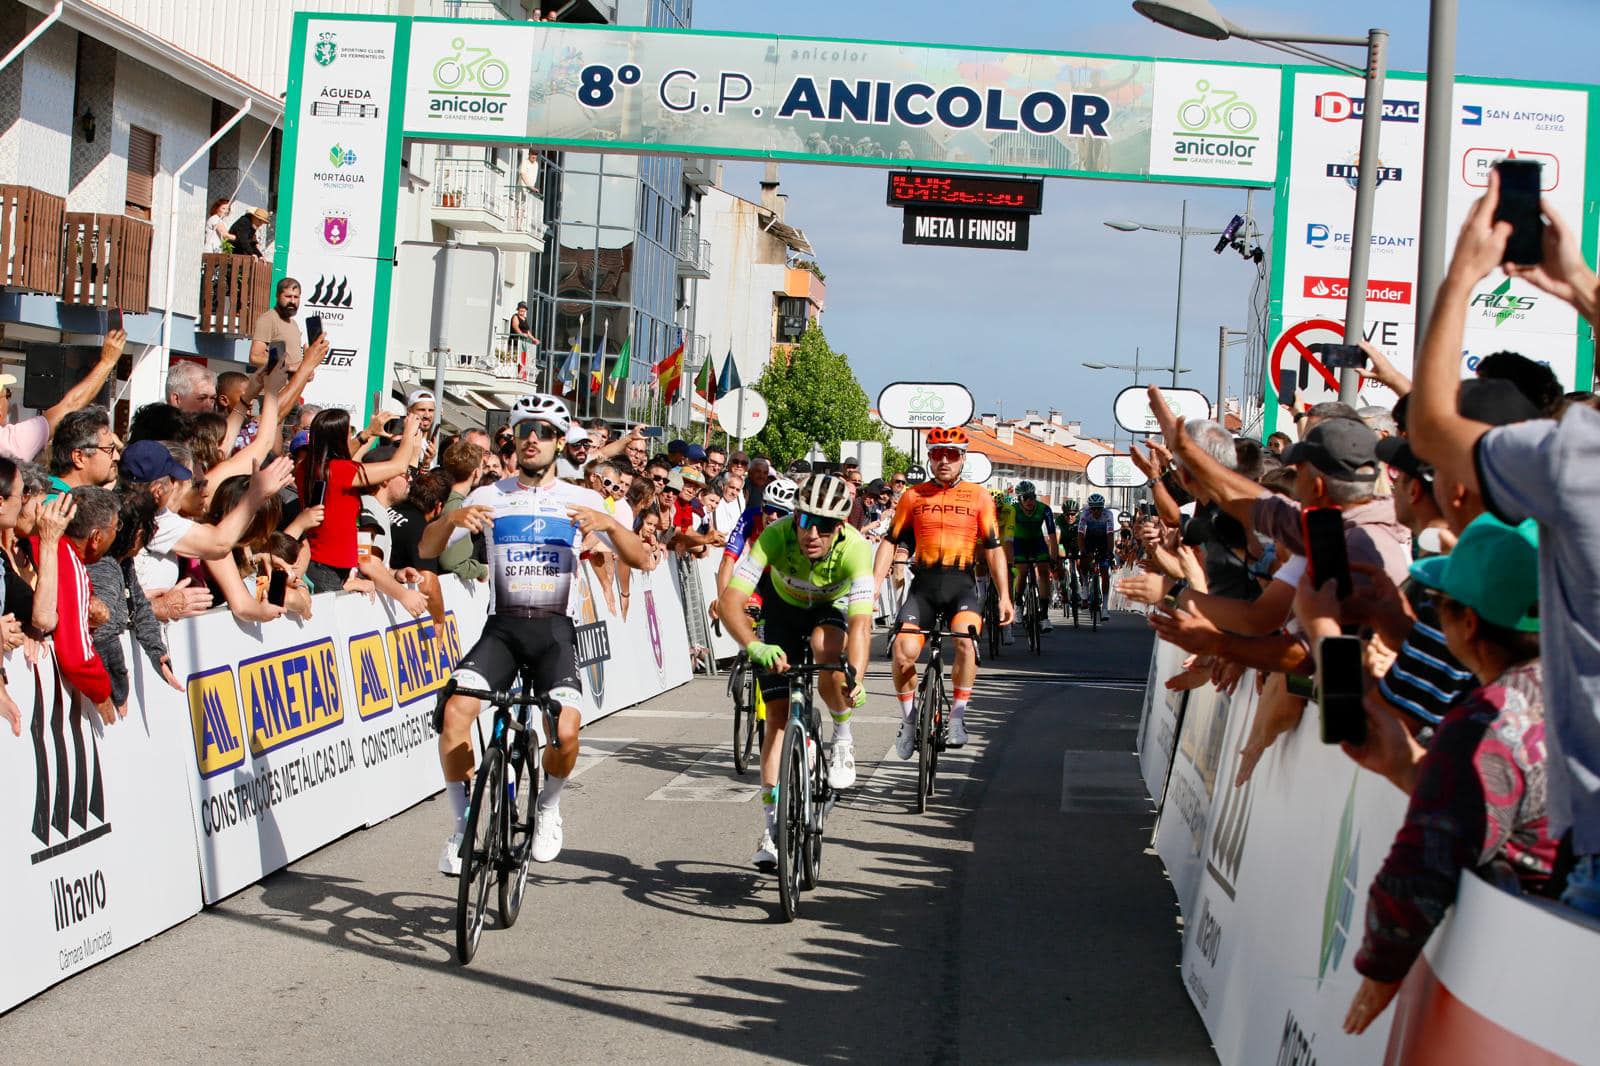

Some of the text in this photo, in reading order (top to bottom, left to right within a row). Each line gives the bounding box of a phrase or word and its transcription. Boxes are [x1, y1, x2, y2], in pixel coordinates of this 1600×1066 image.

[790, 47, 868, 63] anicolor
[320, 86, 371, 99] ÁGUEDA
[429, 96, 508, 114] anicolor
[659, 70, 762, 115] G.P.
[776, 76, 1111, 140] ANICOLOR
[1320, 94, 1419, 120] DURAL
[1486, 109, 1565, 122] SAN ANTONIO
[1174, 138, 1256, 158] anicolor
[915, 216, 955, 238] META
[968, 218, 1017, 242] FINISH
[1334, 233, 1415, 247] PEEDANT
[1331, 283, 1404, 300] Saander
[909, 413, 945, 423] anicolor
[912, 503, 976, 518] EFAPEL
[506, 547, 560, 564] tavira
[505, 565, 561, 578] SC FARENSE
[576, 626, 609, 663] LIMITE
[250, 648, 341, 744] AMETAIS
[361, 714, 421, 769] CONSTRUÇÕES
[201, 737, 356, 837] CONSTRUÇÕES METÁLICAS LDA
[83, 925, 113, 960] Municipal
